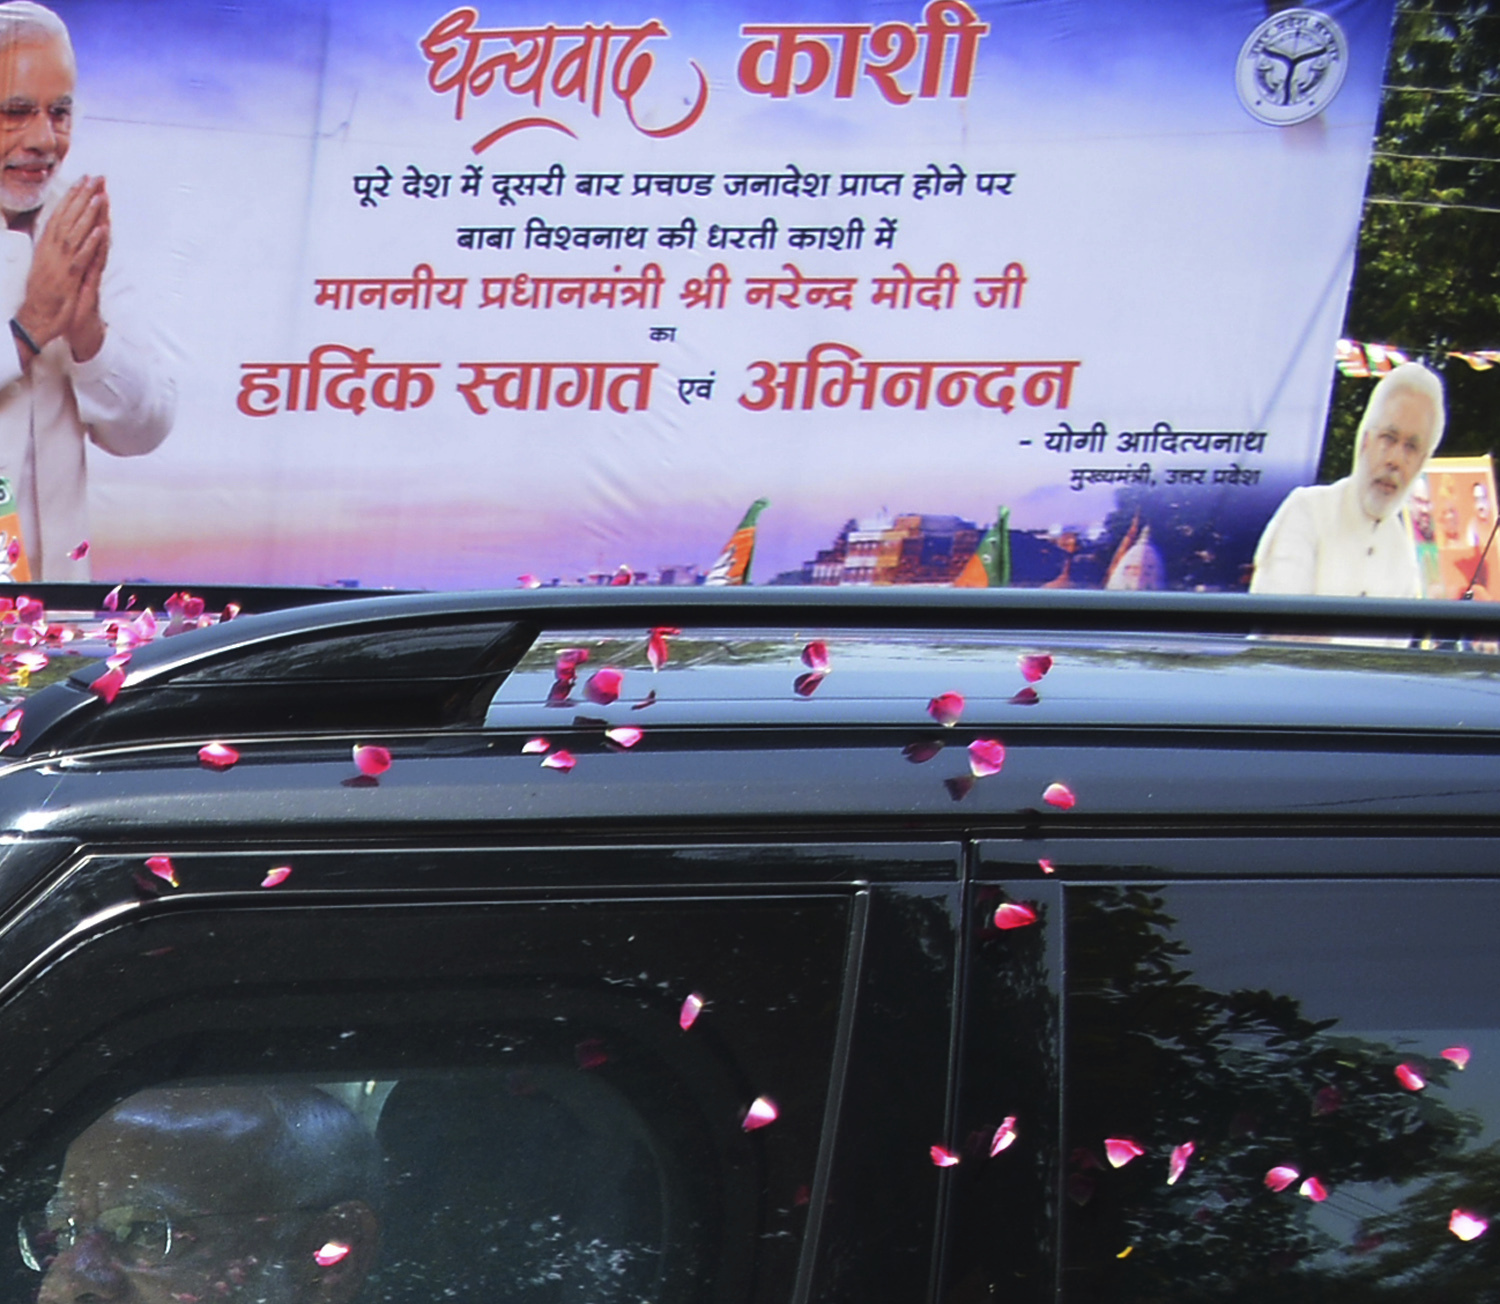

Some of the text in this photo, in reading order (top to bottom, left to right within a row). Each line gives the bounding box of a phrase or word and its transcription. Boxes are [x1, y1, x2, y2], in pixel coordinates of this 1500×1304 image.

[420, 0, 988, 138] धन्यवाद काशी
[353, 163, 1016, 207] पूरे देश में दूसरी बार प्रचण्ड जनादेश प्राप्त होने पर
[456, 216, 898, 251] बाबा विश्वनाथ की धरती काशी में
[314, 262, 1027, 311] माननीय प्रधानमंत्री श्री नरेन्द्र मोदी जी
[649, 326, 677, 343] का
[236, 341, 1081, 417] हार्दिक स्वागत एवं अभिनन्दन
[1044, 422, 1107, 453] योगी
[1116, 422, 1267, 454] आदित्यनाथ
[1165, 469, 1206, 486] उत्तर
